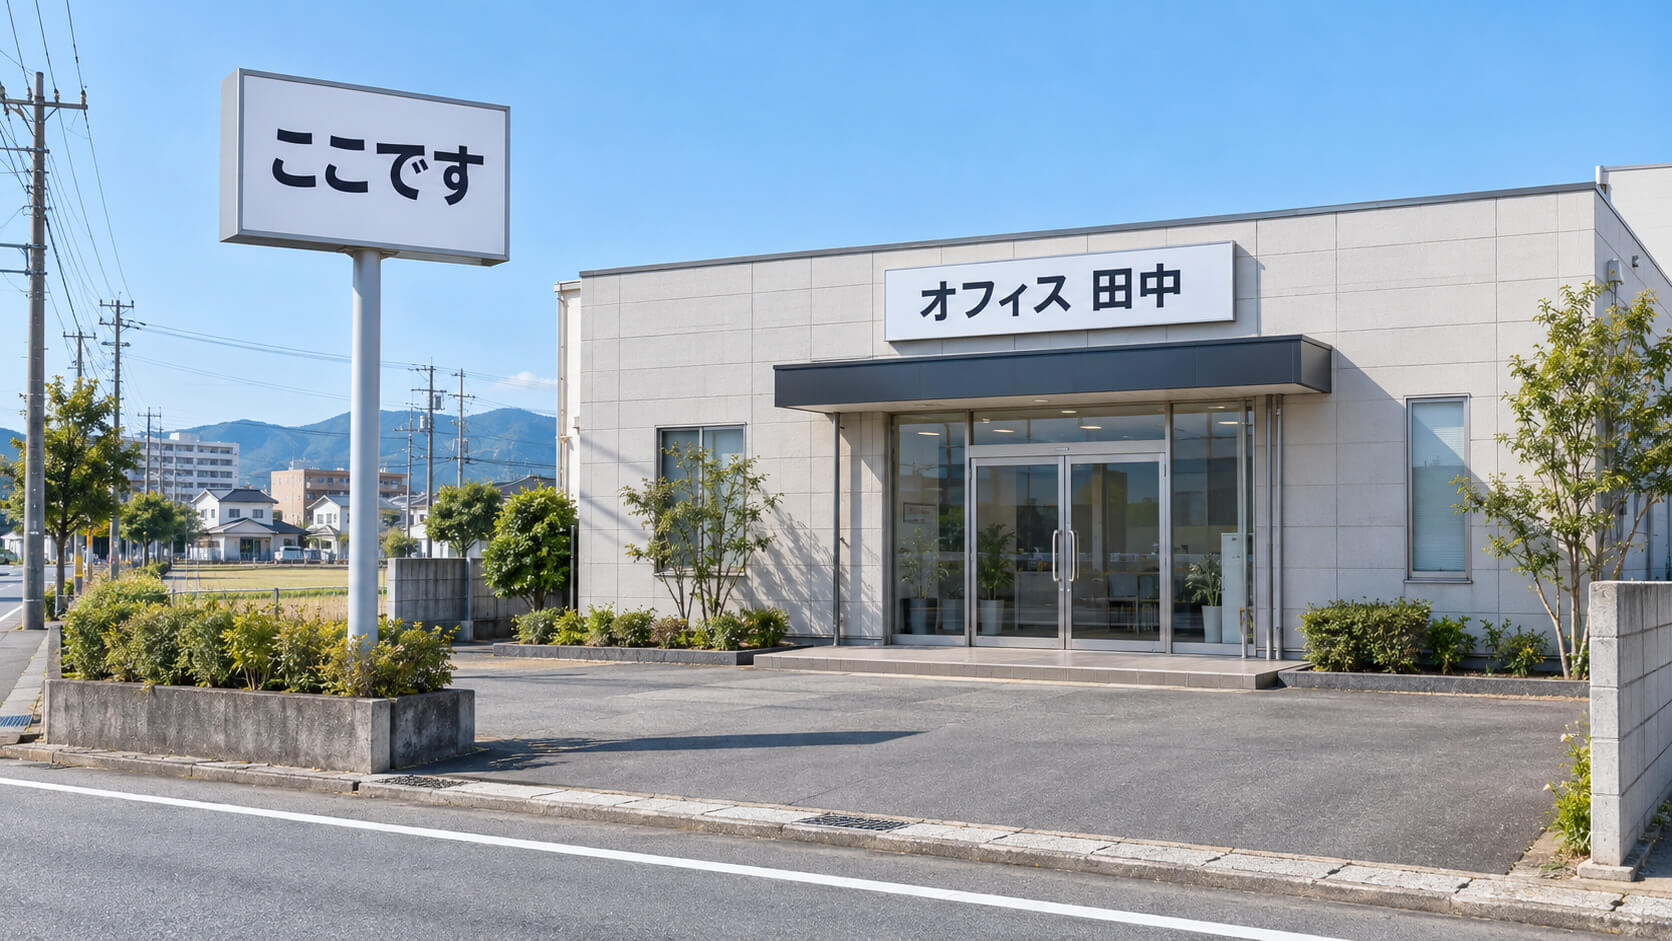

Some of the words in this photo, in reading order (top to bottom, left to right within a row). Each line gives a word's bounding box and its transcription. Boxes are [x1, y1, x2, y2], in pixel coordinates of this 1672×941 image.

[272, 128, 484, 206] ここです
[920, 275, 1071, 321] オフィス
[1092, 263, 1181, 311] 田中
